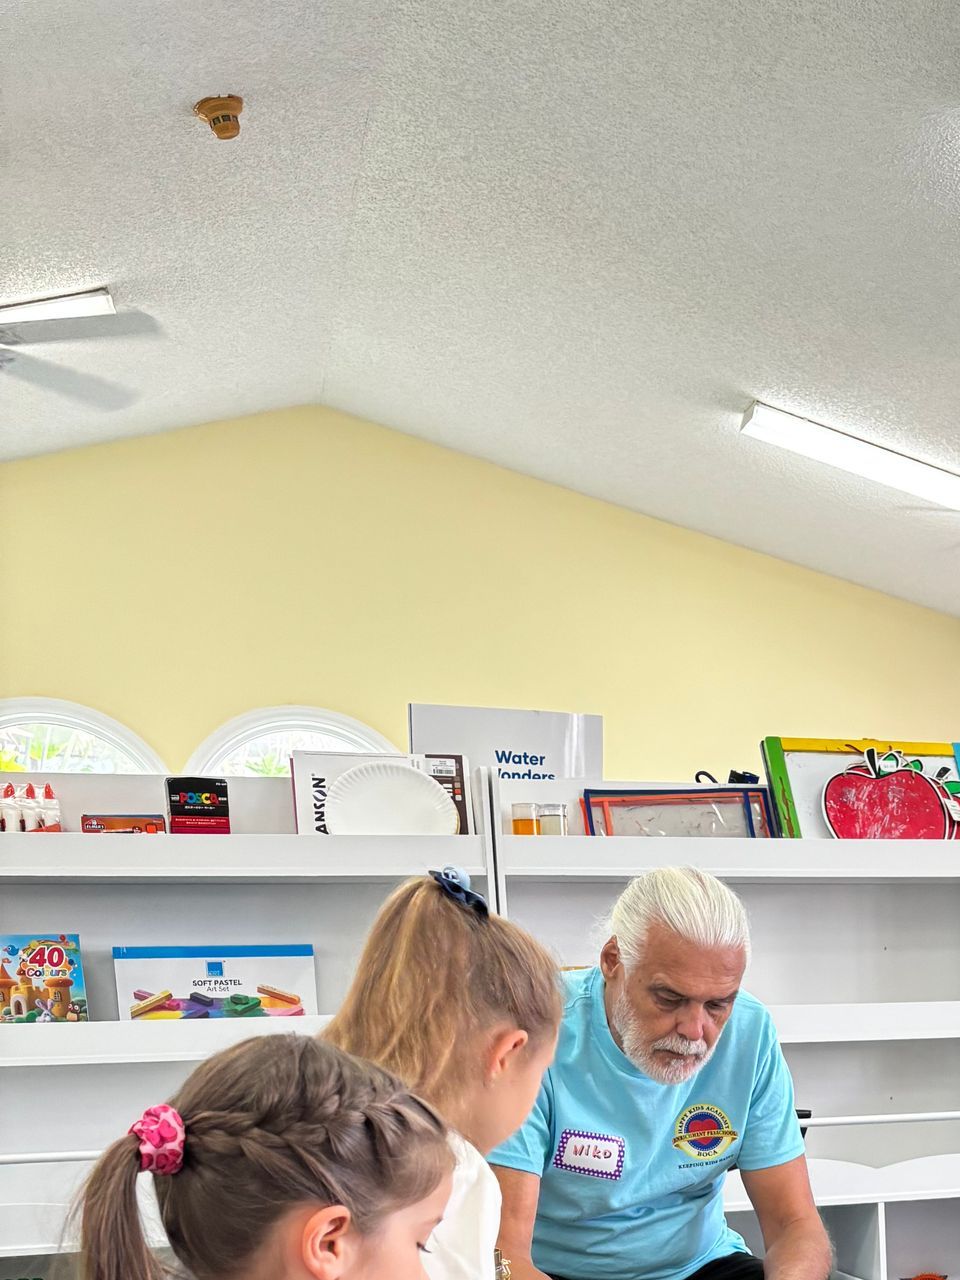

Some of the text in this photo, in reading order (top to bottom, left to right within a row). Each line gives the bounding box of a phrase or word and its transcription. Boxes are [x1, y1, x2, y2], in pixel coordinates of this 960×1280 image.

[495, 750, 546, 766] Water
[497, 767, 556, 781] onders
[179, 792, 219, 805] POSCA
[28, 946, 65, 968] 40
[26, 967, 68, 978] Colours
[192, 979, 212, 987] SOFT
[697, 1150, 718, 1158] BOCA
